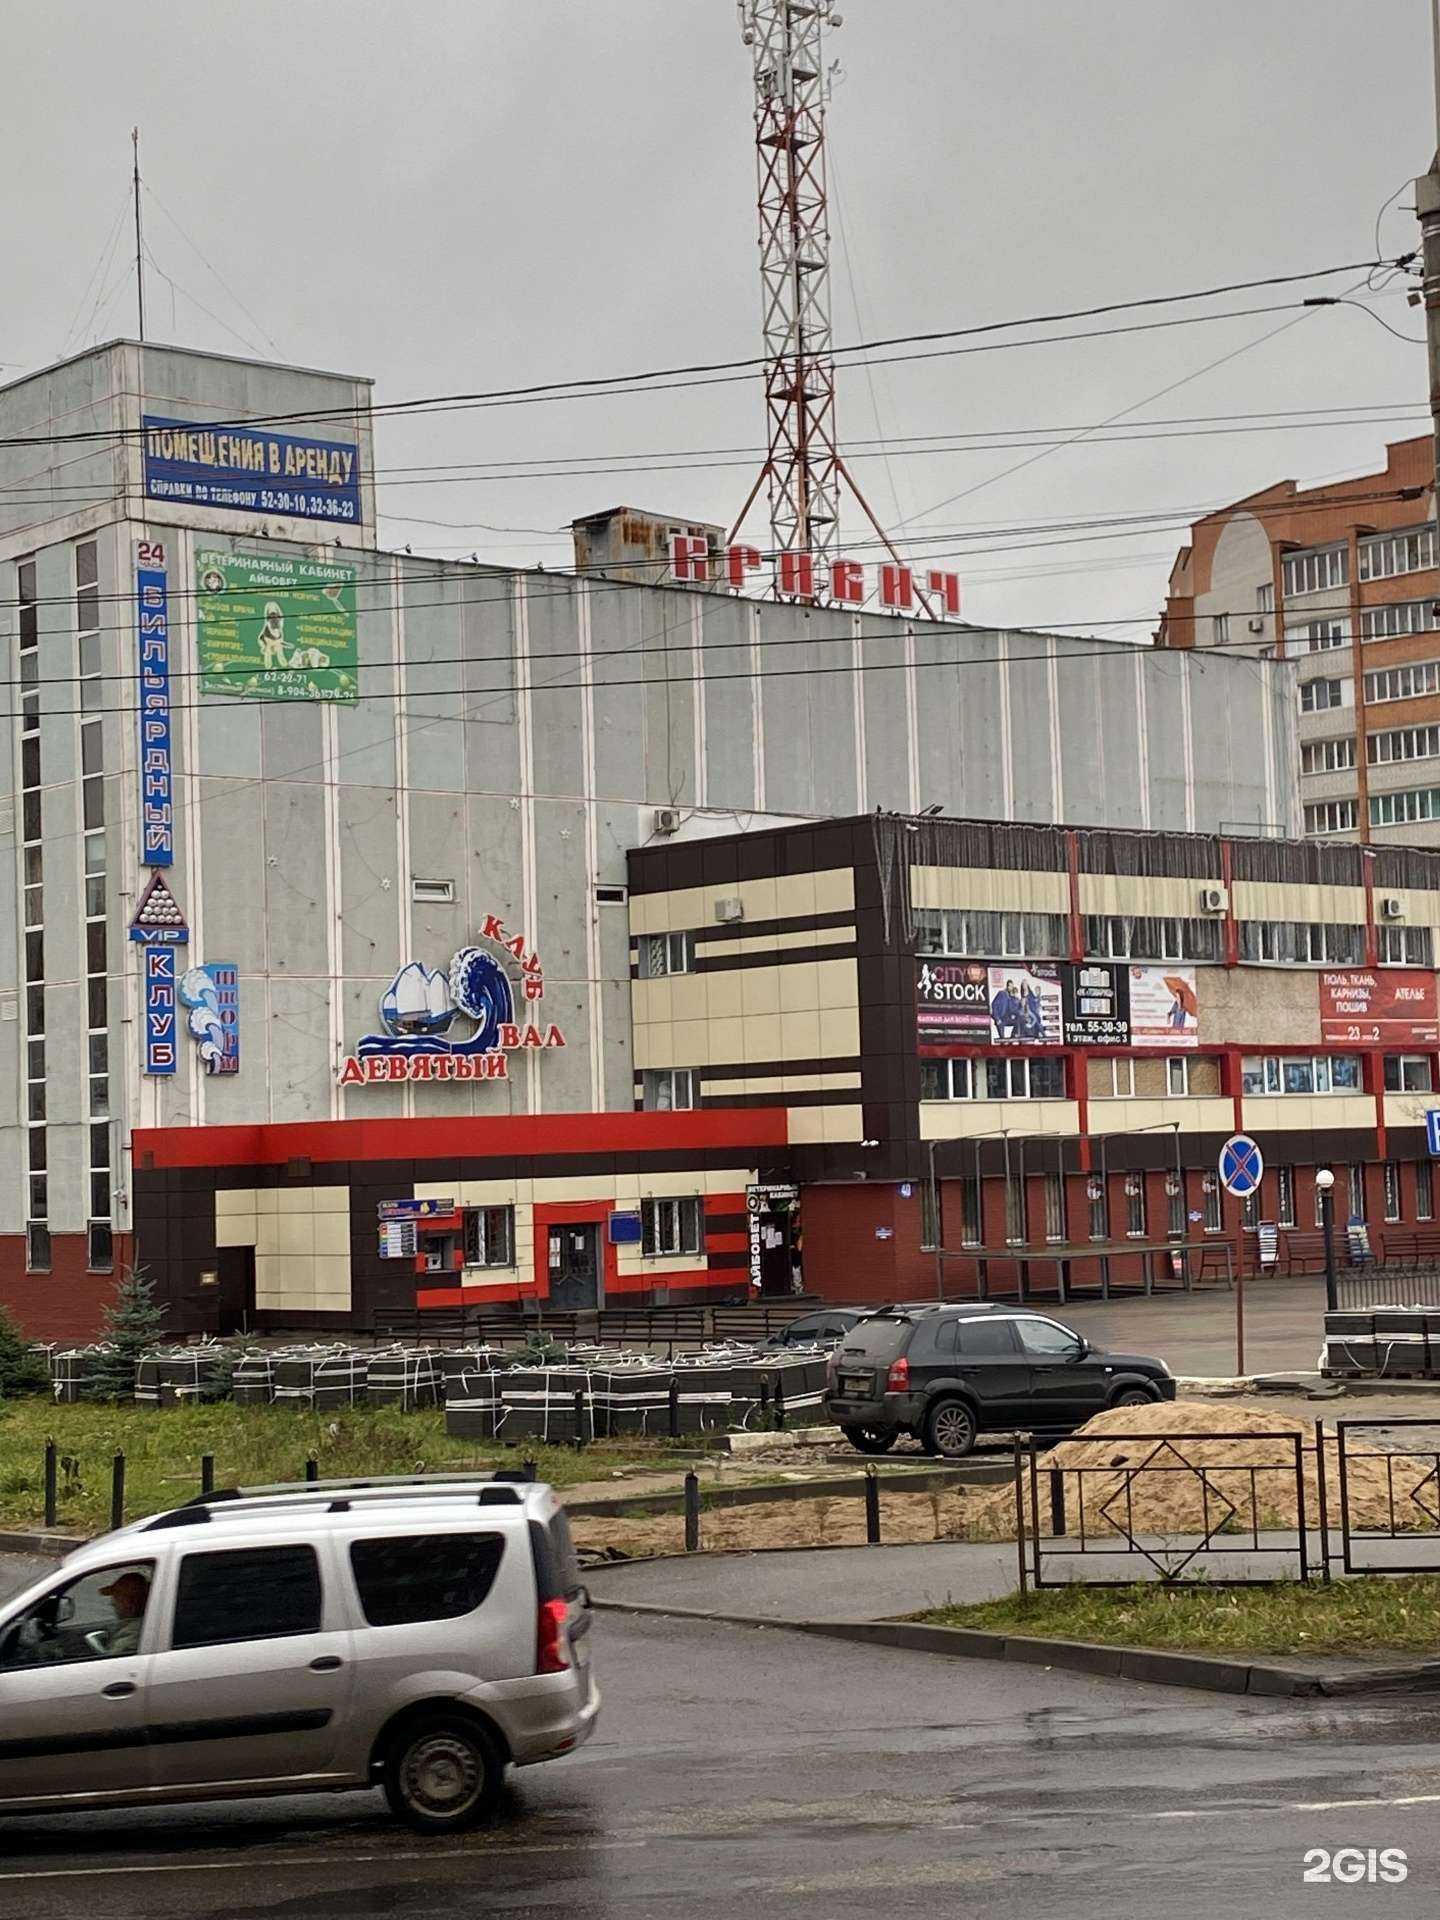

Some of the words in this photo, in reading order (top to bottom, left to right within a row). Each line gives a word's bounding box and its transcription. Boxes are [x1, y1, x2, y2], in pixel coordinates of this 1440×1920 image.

[148, 426, 265, 472] ПОМЕЩЕНИЯ
[269, 442, 281, 474] В
[285, 444, 353, 485] АРЕНДУ
[150, 478, 192, 498] СПРАВКИ
[196, 485, 208, 500] ПО
[210, 487, 256, 506] ТЕЛЕФОНУ
[138, 542, 165, 562] 24
[200, 552, 294, 574] ВЕТЕРИНАРНЫЙ
[300, 565, 352, 581] КАБИНЕТ
[141, 585, 172, 851] БИЛЬЯРДНЫЙ
[478, 912, 545, 1002] КЛУБ
[934, 966, 966, 983] CITY
[934, 982, 986, 1001] STOCK
[1394, 987, 1425, 1000] АТЕЛЬЕ
[149, 953, 174, 1066] КЛУБ
[1336, 1001, 1368, 1013] ПОШИВ
[500, 1023, 566, 1050] ВАЛ
[1065, 1022, 1085, 1033] тел.
[1087, 1020, 1128, 1033] 55-30-30
[1347, 1025, 1361, 1041] 23
[1372, 1025, 1380, 1041] 2
[1122, 1034, 1128, 1043] 3
[339, 1047, 509, 1085] ДЕВЯТЫЙ
